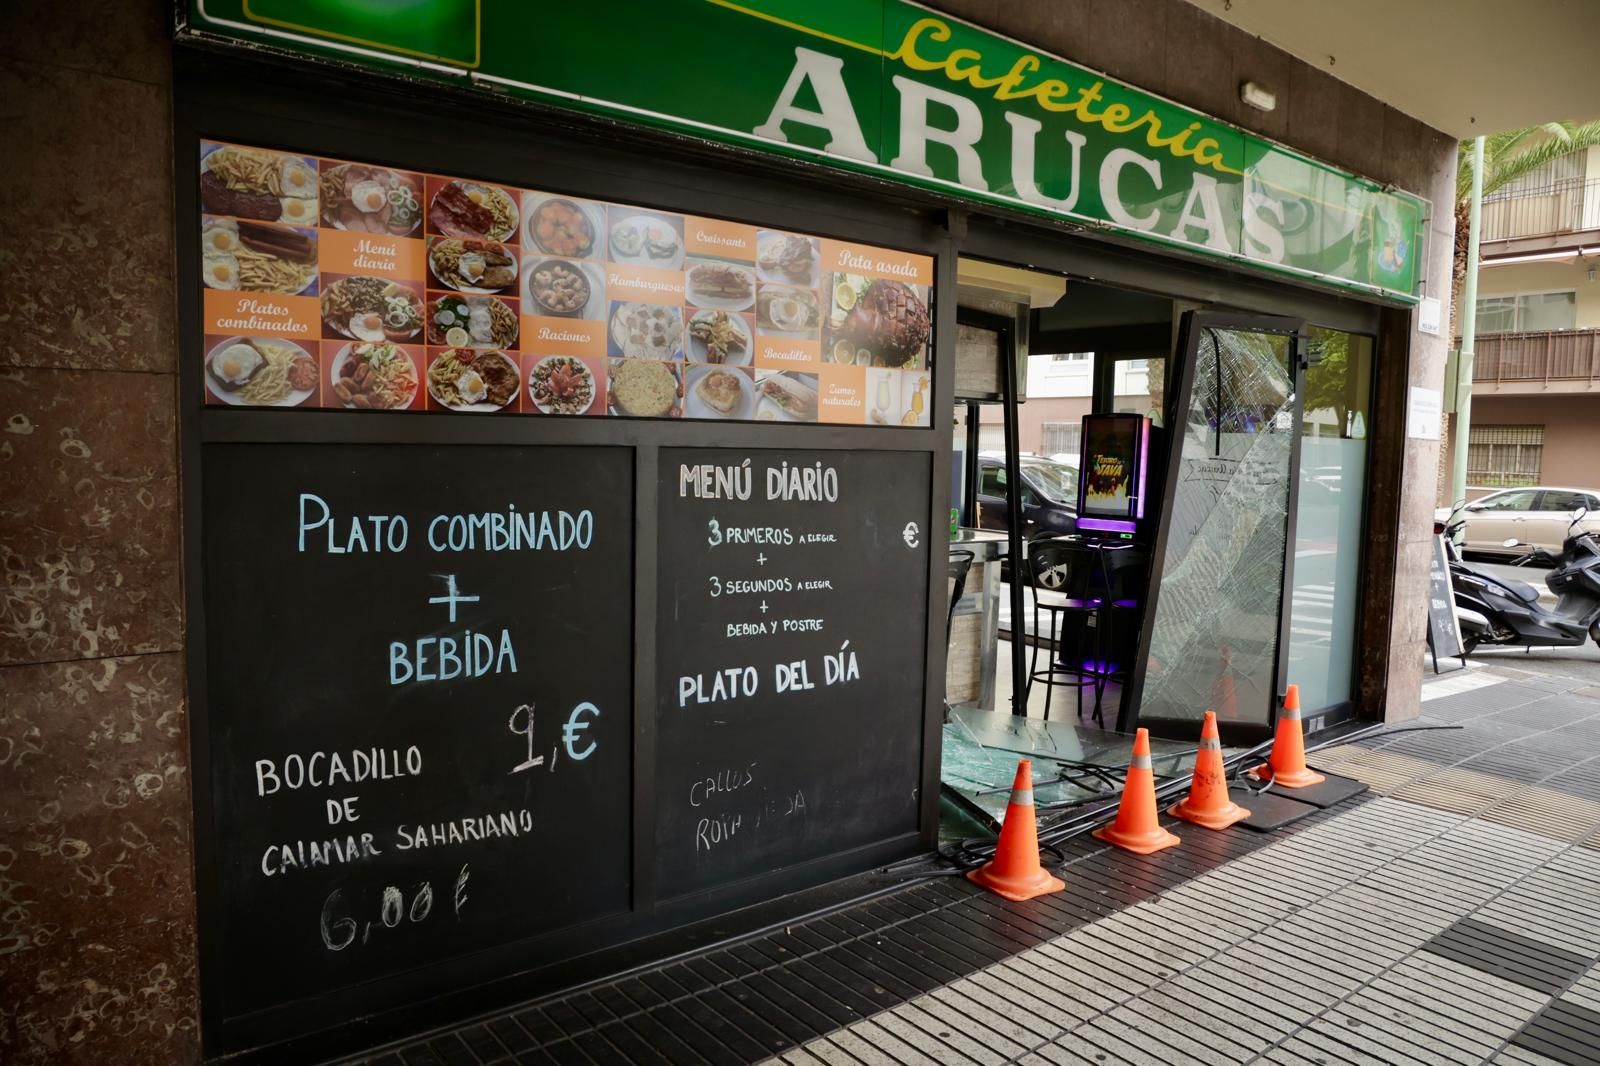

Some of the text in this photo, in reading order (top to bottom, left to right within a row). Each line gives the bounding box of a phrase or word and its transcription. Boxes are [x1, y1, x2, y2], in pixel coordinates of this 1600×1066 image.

[753, 46, 1286, 266] ARUCAS
[353, 239, 397, 257] Menú
[695, 230, 746, 249] Croissants
[353, 257, 396, 271] diario
[838, 250, 918, 277] Pata asada
[608, 273, 685, 293] Hamburguesas
[236, 299, 289, 317] Platos
[216, 317, 308, 333] combinados
[538, 328, 591, 343] Raciones
[763, 347, 812, 363] Bocadillos
[822, 395, 861, 408] naturales
[828, 384, 856, 396] Zumos
[679, 458, 839, 502] MENÚ DIARIO
[427, 503, 593, 552] COMBINADO
[707, 518, 837, 548] 3 PRIMEROS A ELEGIR
[902, 521, 919, 548] €
[428, 574, 480, 622] +
[708, 576, 833, 597] 3 SEGUNDOS A ELEGIR
[726, 619, 824, 638] BEBIDA Y POSTRE
[389, 629, 518, 685] BEBIDA
[679, 639, 860, 708] PLATO DEL DÍA
[255, 745, 422, 797] BOCADILLO
[690, 761, 757, 807] CALLOS
[326, 796, 360, 825] DE
[261, 809, 533, 876] CALAMAR SAHARIANO
